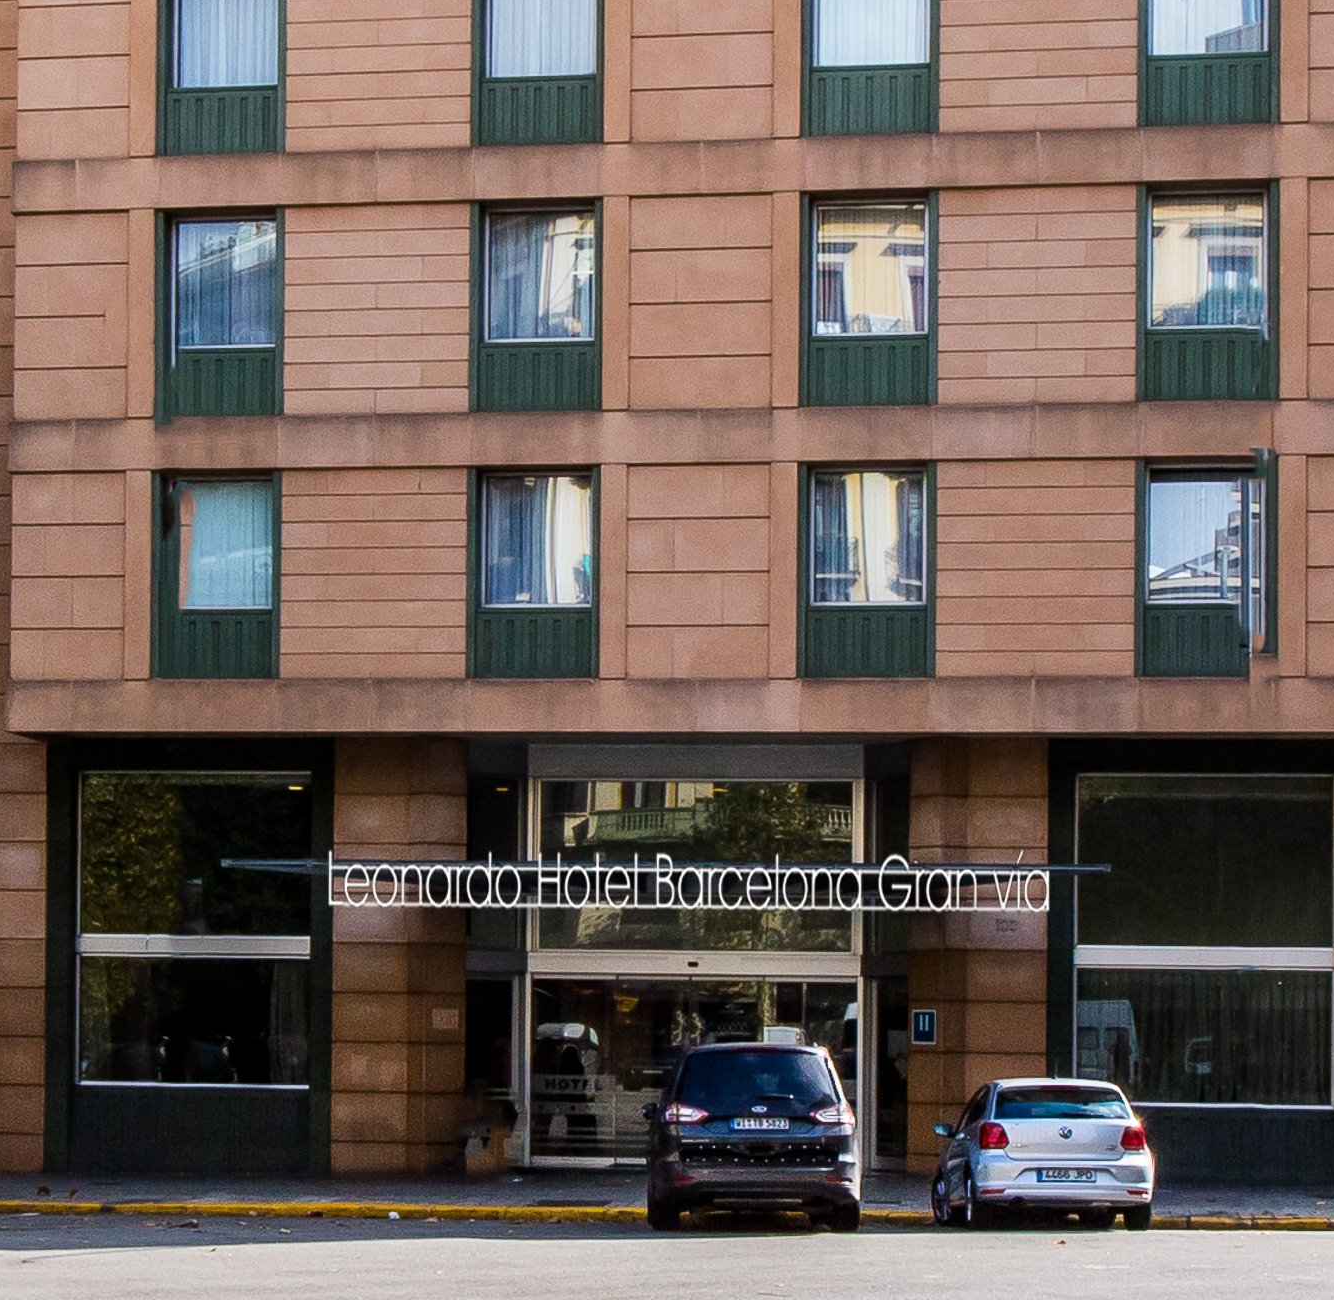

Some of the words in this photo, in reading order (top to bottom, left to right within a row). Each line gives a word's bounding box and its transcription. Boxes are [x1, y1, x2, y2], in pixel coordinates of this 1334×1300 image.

[329, 850, 521, 907] Leonardo
[538, 852, 639, 909] Hotel
[656, 853, 862, 911] Barcelona
[879, 854, 977, 912] Gran
